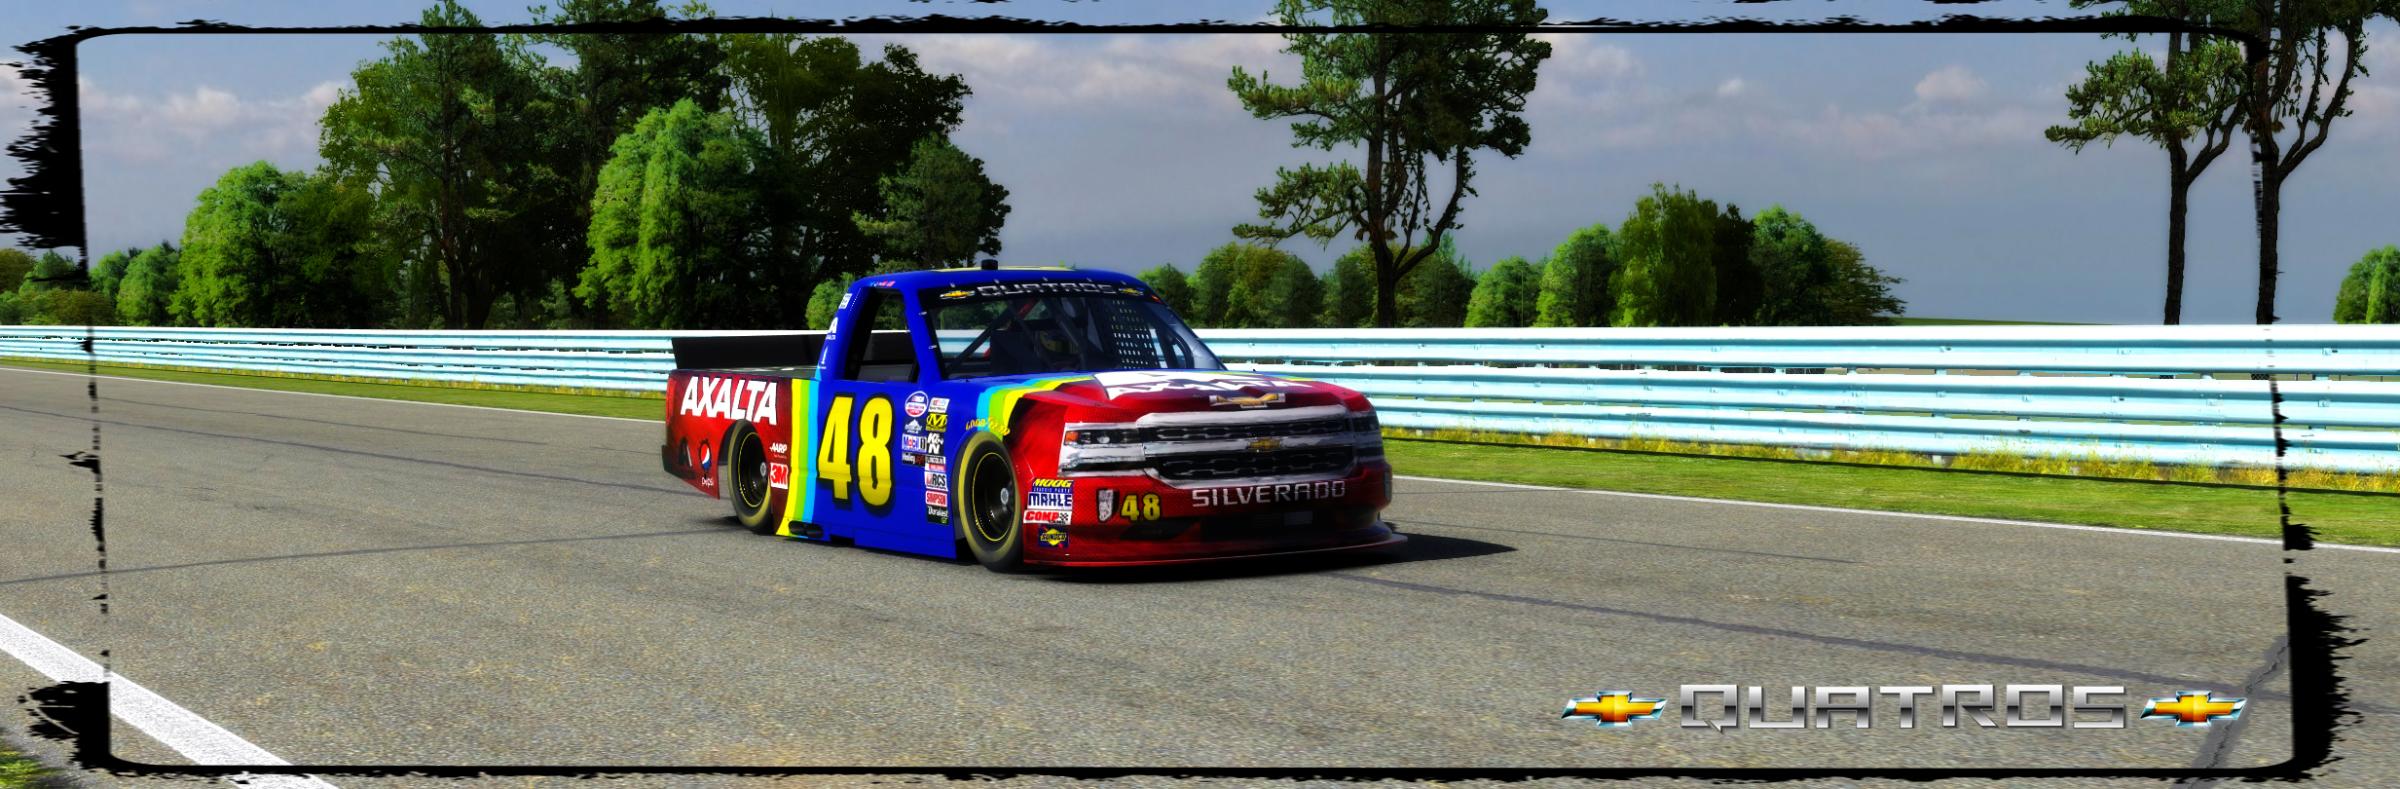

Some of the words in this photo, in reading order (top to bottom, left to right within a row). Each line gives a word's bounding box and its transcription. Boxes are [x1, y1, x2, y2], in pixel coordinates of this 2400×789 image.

[680, 376, 777, 426] AXALTA
[816, 395, 894, 507] 48
[770, 465, 788, 487] 3M
[1033, 478, 1073, 488] MOOG
[1028, 493, 1072, 507] MAHLE
[1192, 480, 1346, 507] SILVERADO
[1025, 510, 1060, 521] COMP
[1121, 493, 1161, 521] 48
